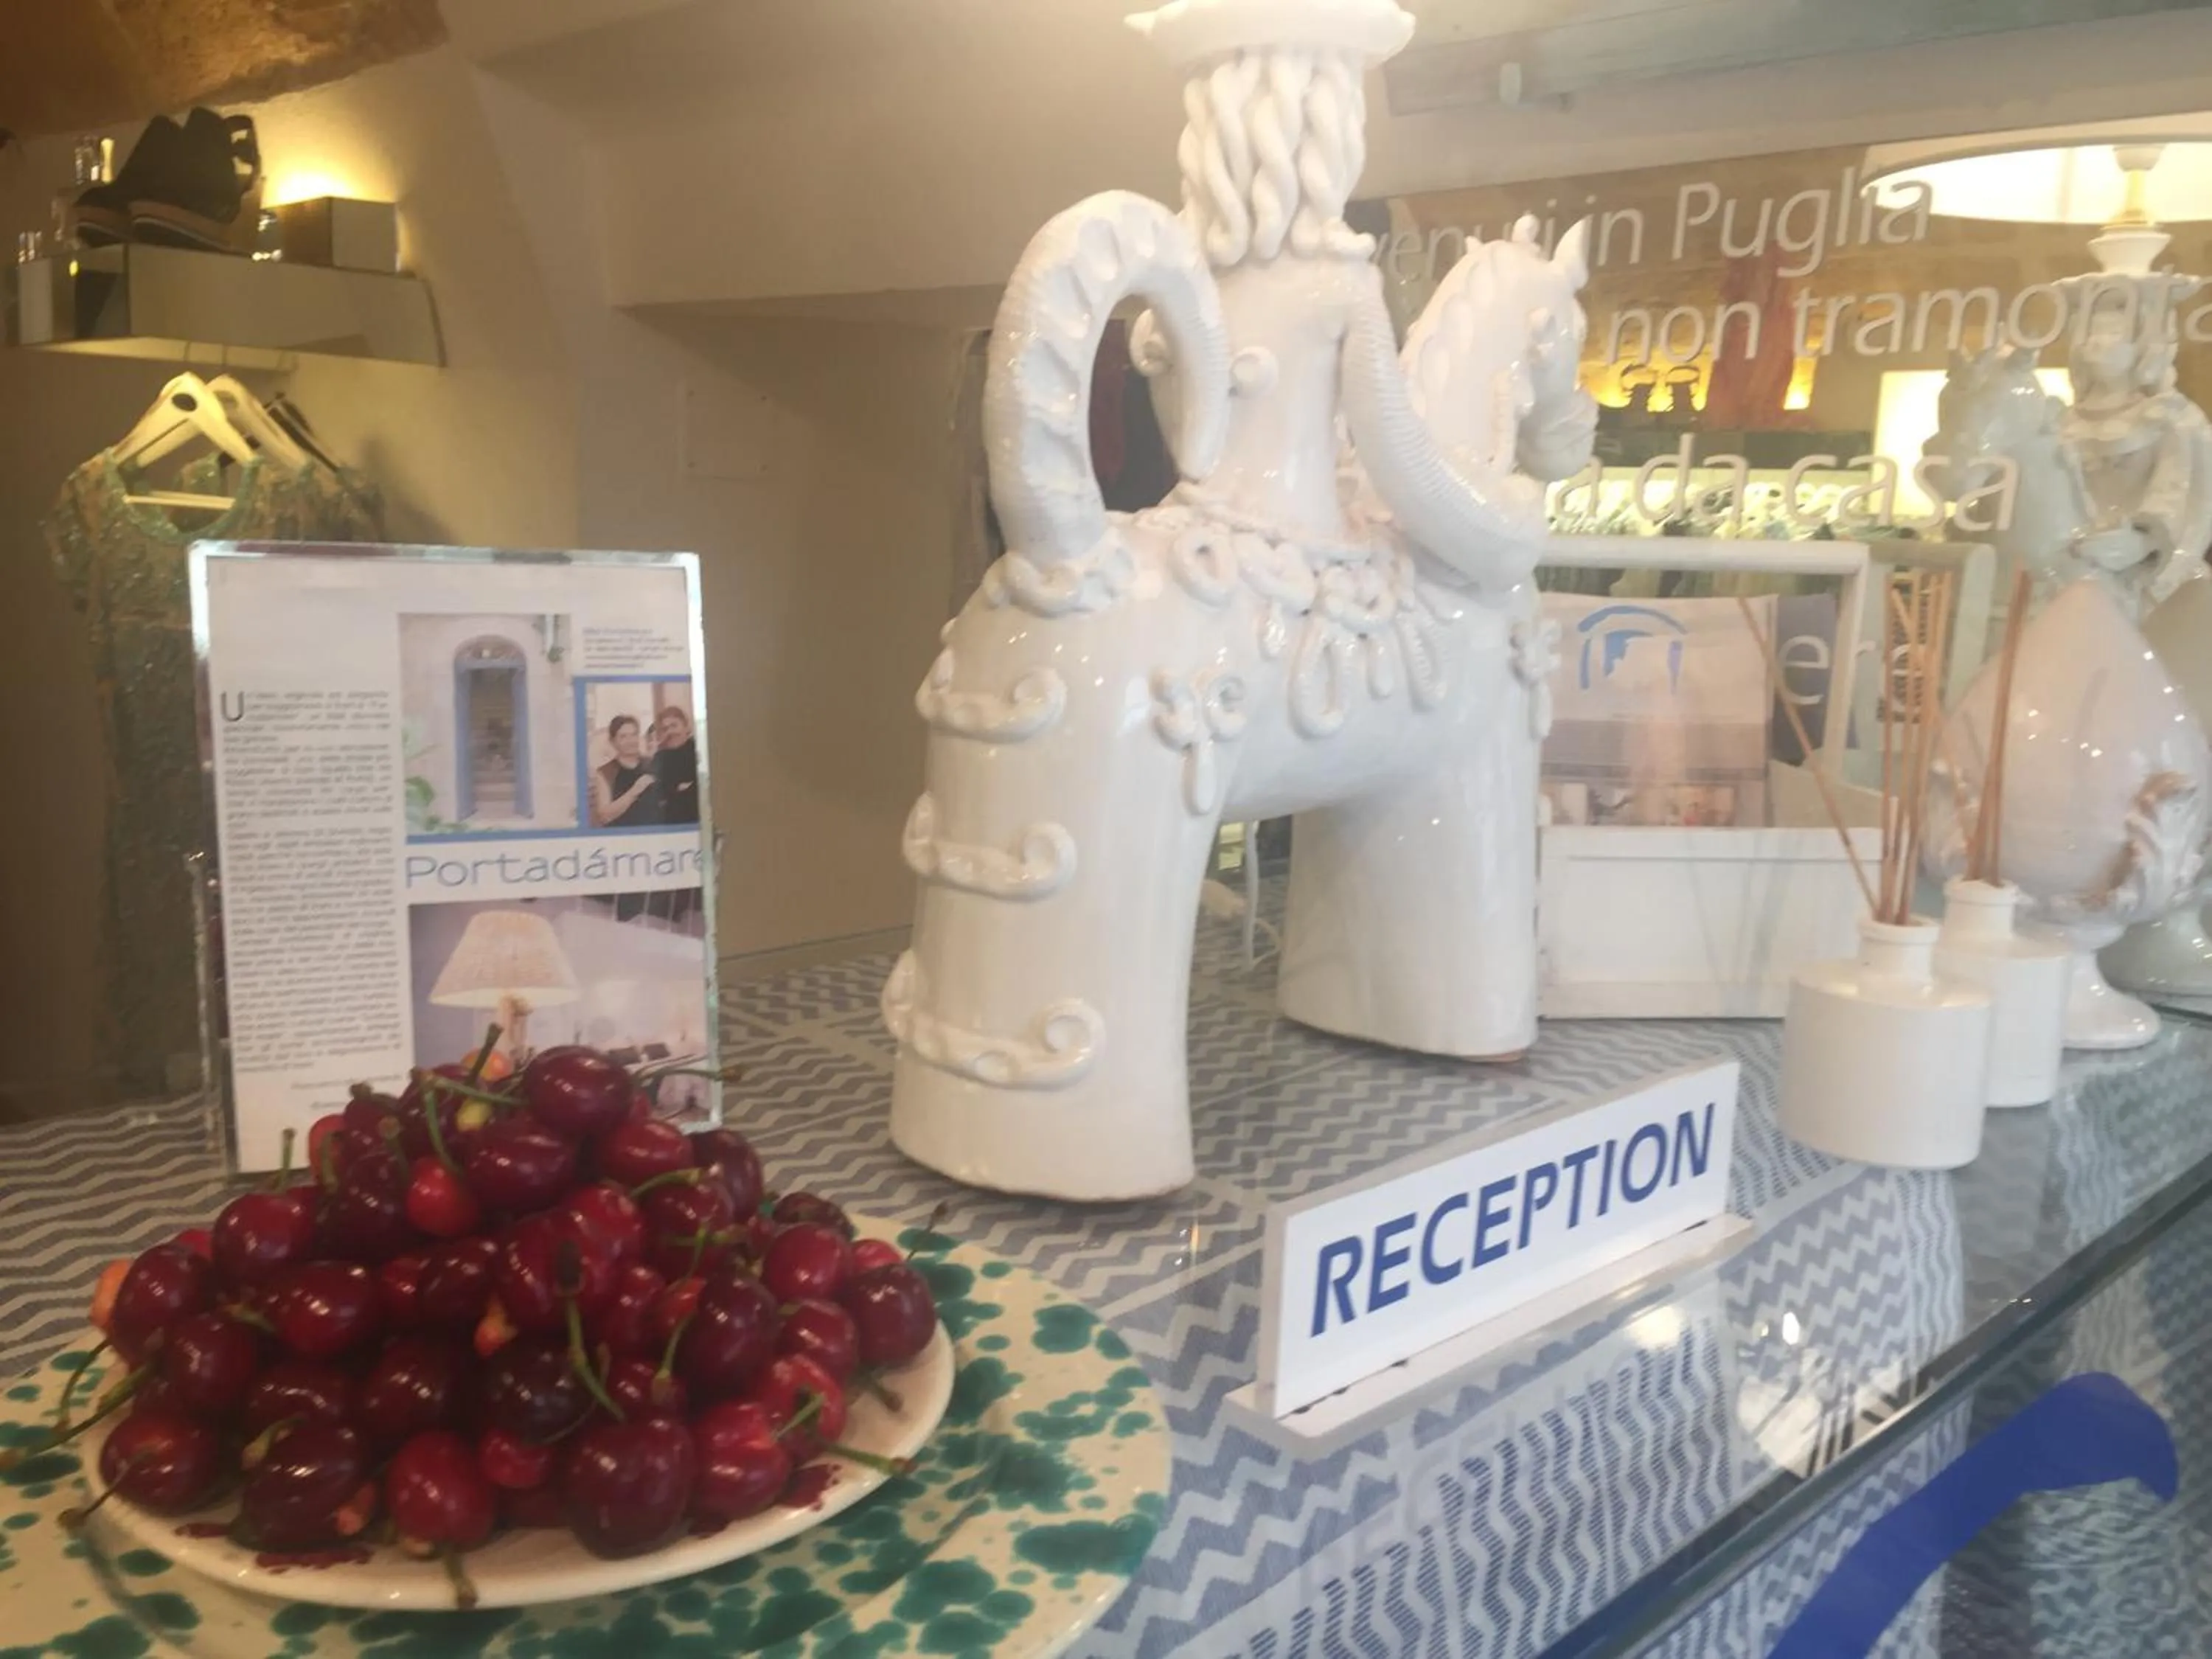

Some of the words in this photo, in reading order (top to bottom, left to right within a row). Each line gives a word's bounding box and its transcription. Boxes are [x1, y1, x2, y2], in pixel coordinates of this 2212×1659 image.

[1671, 167, 1933, 278] Puglia
[1606, 299, 1761, 366] non
[1633, 432, 1748, 525] da
[1785, 453, 2019, 532] casa
[1310, 1102, 1717, 1339] RECEPTION
